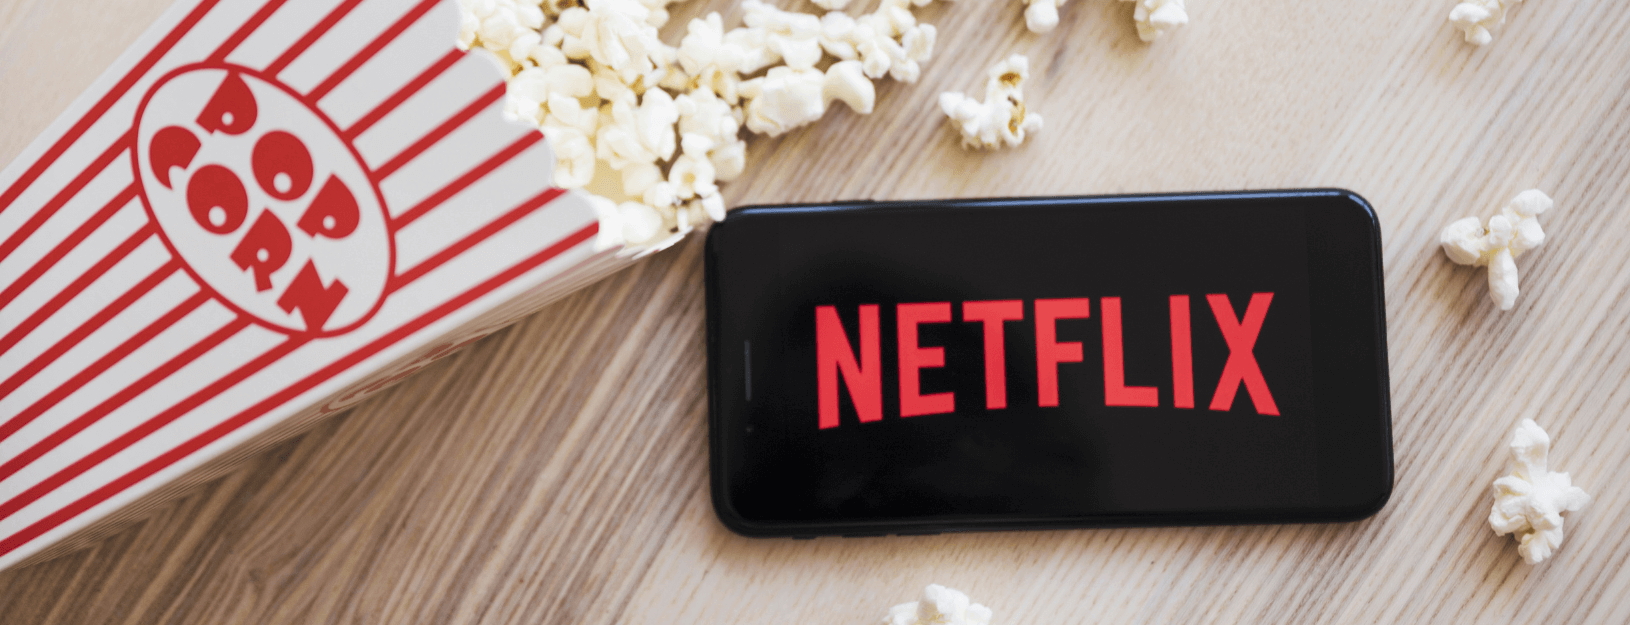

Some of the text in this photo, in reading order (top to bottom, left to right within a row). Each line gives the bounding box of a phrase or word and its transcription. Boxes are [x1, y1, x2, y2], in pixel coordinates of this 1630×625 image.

[148, 125, 349, 332] CORN
[195, 71, 361, 241] POP
[815, 291, 1281, 430] NETFLIX
